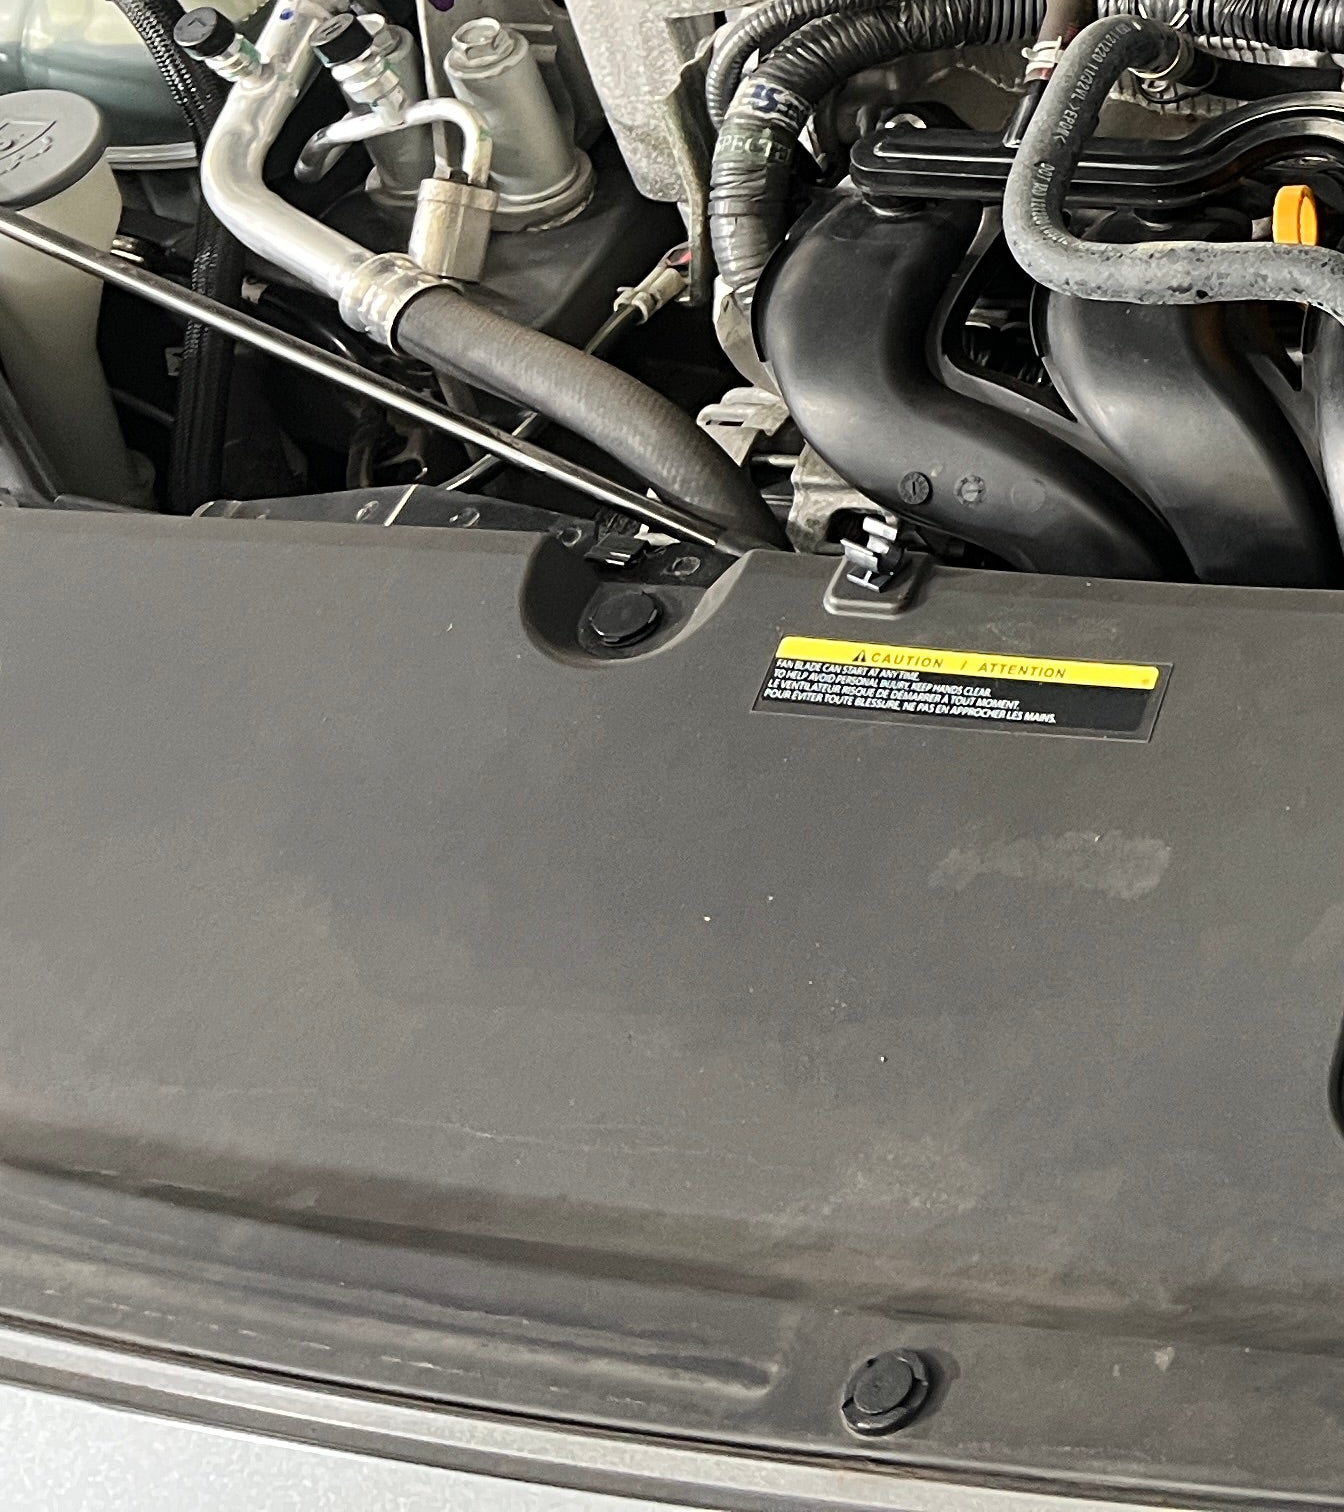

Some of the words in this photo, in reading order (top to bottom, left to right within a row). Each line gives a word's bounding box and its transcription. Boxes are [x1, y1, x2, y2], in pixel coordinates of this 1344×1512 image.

[776, 659, 794, 668] FAN
[794, 660, 822, 671] BLADE
[822, 662, 842, 673] CAN
[842, 664, 868, 676] START
[868, 667, 880, 677] AT
[879, 668, 898, 678] ANY
[871, 652, 944, 669] CAUTION
[978, 662, 1067, 679] ATTENTION
[768, 679, 780, 688] LE
[780, 680, 842, 694] VENTILATEUR
[841, 685, 875, 697] RISQUE
[875, 688, 889, 698] DE
[950, 695, 976, 706] TOUT
[774, 668, 786, 678] TO
[786, 669, 808, 680] HELP
[807, 672, 835, 683] AVOID
[835, 675, 879, 687] PERSONAL
[910, 681, 933, 692] KEEP
[932, 683, 963, 695] HANDS
[763, 688, 791, 699] POUR
[823, 694, 855, 705] TOUTE
[902, 701, 916, 712] NE
[916, 702, 936, 713] PAS
[935, 705, 949, 715] EN
[949, 705, 1005, 719] APPROCHER
[1006, 710, 1023, 721] LES
